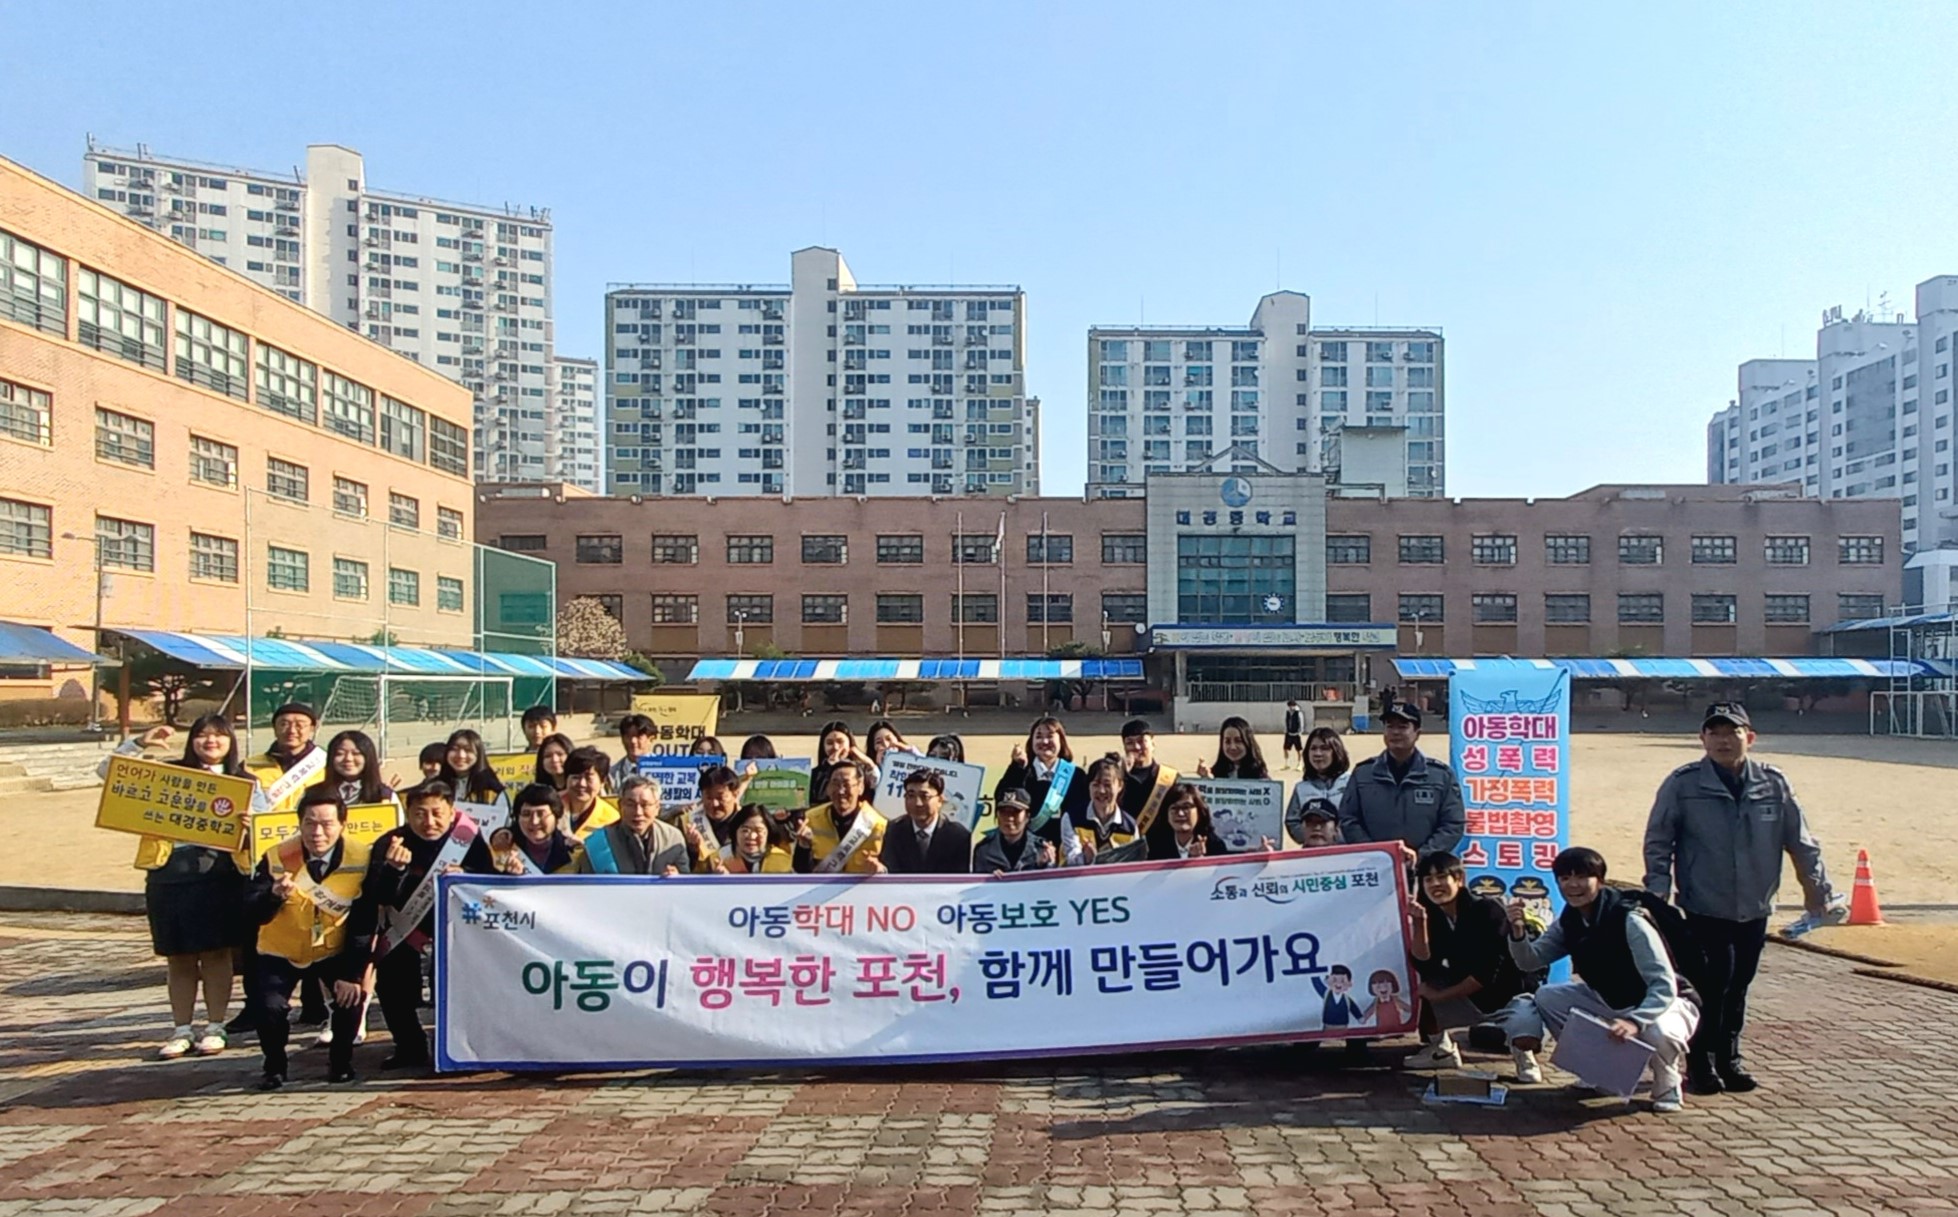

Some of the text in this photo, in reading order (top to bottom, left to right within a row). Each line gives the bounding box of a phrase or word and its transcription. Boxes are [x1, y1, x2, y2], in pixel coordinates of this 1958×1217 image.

[653, 725, 706, 741] 동학대
[1463, 714, 1557, 740] 아동학대
[116, 763, 157, 782] 언어가
[160, 772, 192, 790] 사람을
[111, 781, 208, 813] 바르고 고운말을
[661, 787, 693, 801] 생활의
[1464, 778, 1556, 804] 가정폭력
[143, 809, 236, 836] 쓰는 대경중학교
[346, 820, 384, 835] 만드는
[1464, 810, 1556, 837] 불법촬영
[1461, 842, 1559, 869] 스토킹
[1210, 884, 1248, 901] 소통과
[1251, 881, 1289, 898] 신뢰의
[1292, 874, 1348, 893] 시민중심
[1351, 871, 1380, 888] 포천
[482, 910, 536, 931] 포천시
[728, 896, 1131, 938] 아동학대 NO 아동보호 YES
[522, 931, 1328, 1012] 아동이 행복한 포천, 함께 만들어가요
